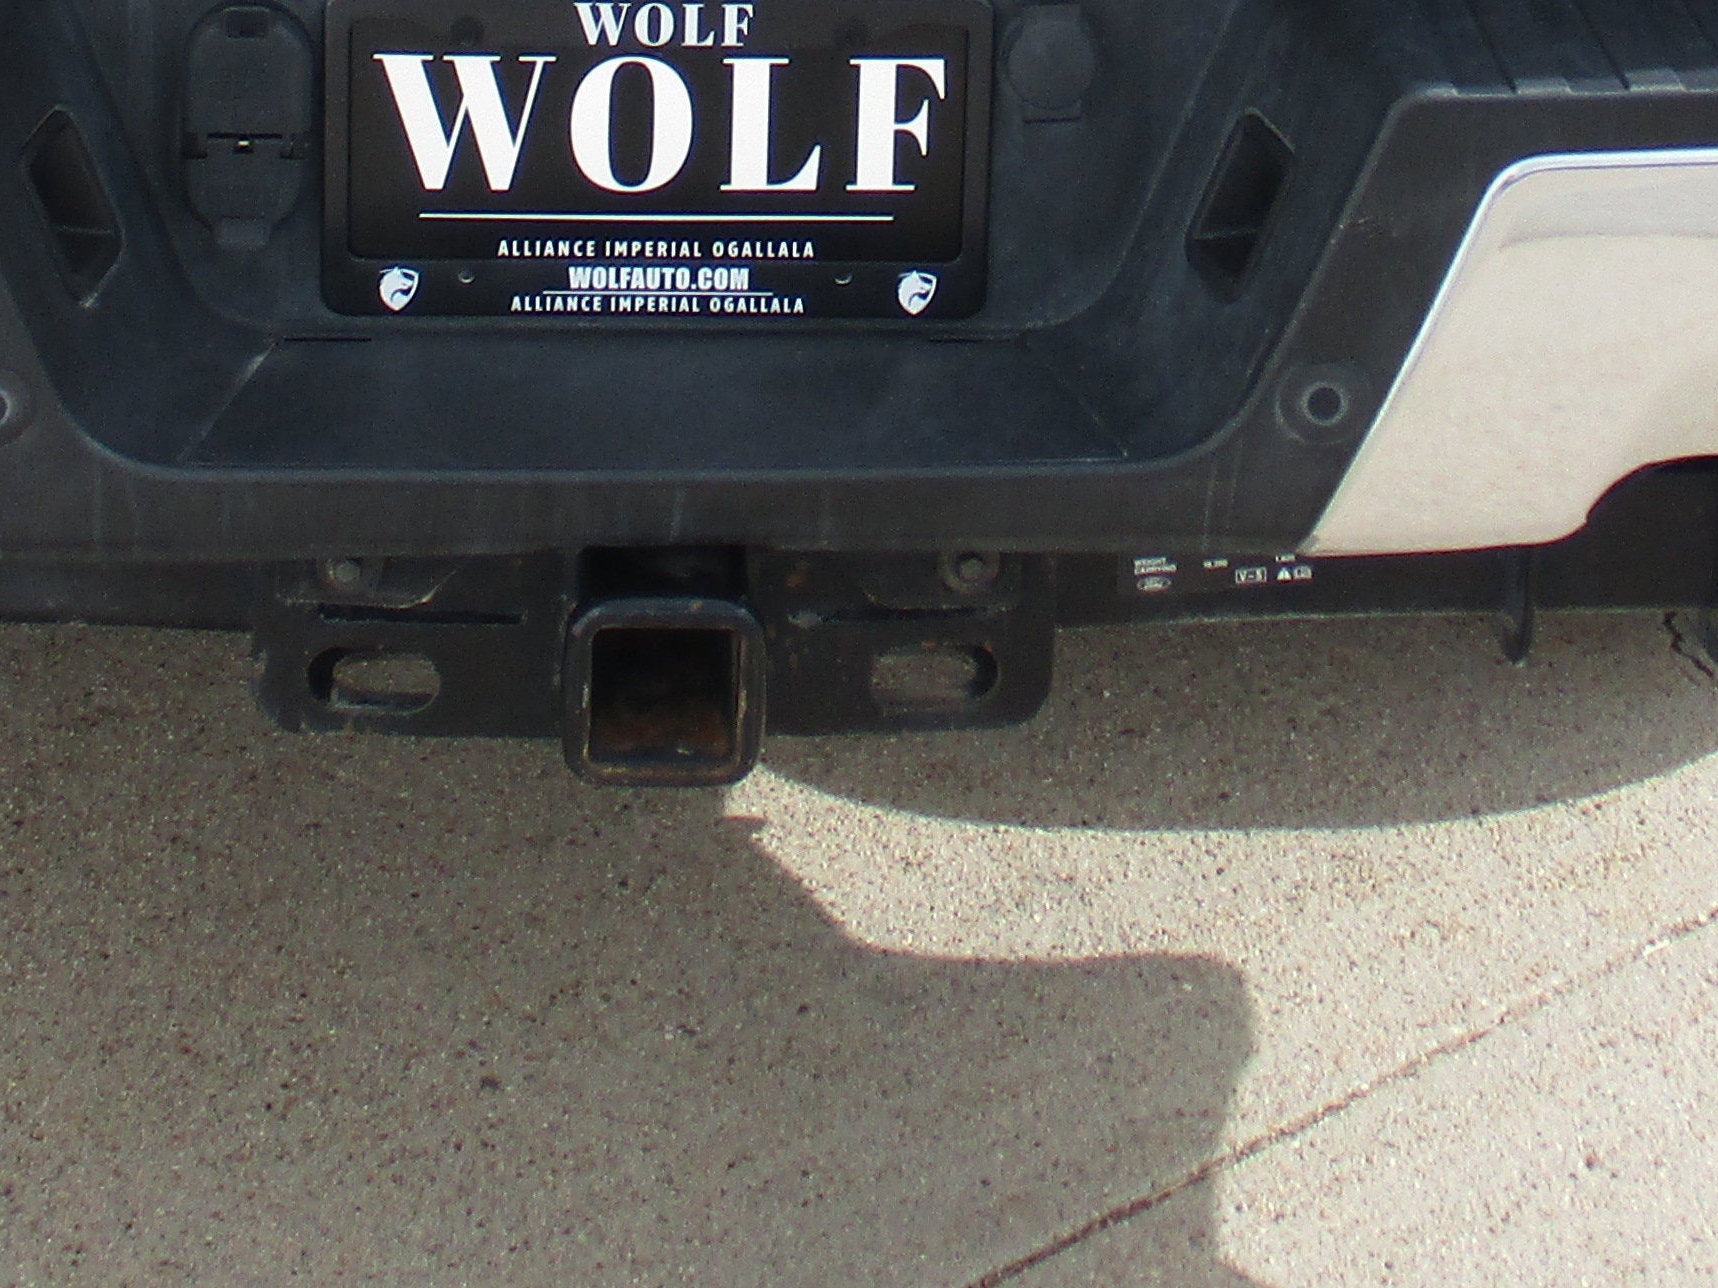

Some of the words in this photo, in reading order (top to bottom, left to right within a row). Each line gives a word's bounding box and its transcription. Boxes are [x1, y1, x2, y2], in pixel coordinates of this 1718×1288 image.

[574, 3, 753, 46] WOLF
[372, 54, 945, 191] WOLF
[497, 240, 595, 257] ALLIANCE
[605, 240, 702, 257] IMPERIAL
[712, 240, 814, 258] OGALLALA
[569, 266, 750, 290] WOLFAUTO.COM
[510, 295, 602, 312] ALLIANCE
[610, 295, 701, 313] IMPERIAL
[710, 296, 805, 313] OGALLALA
